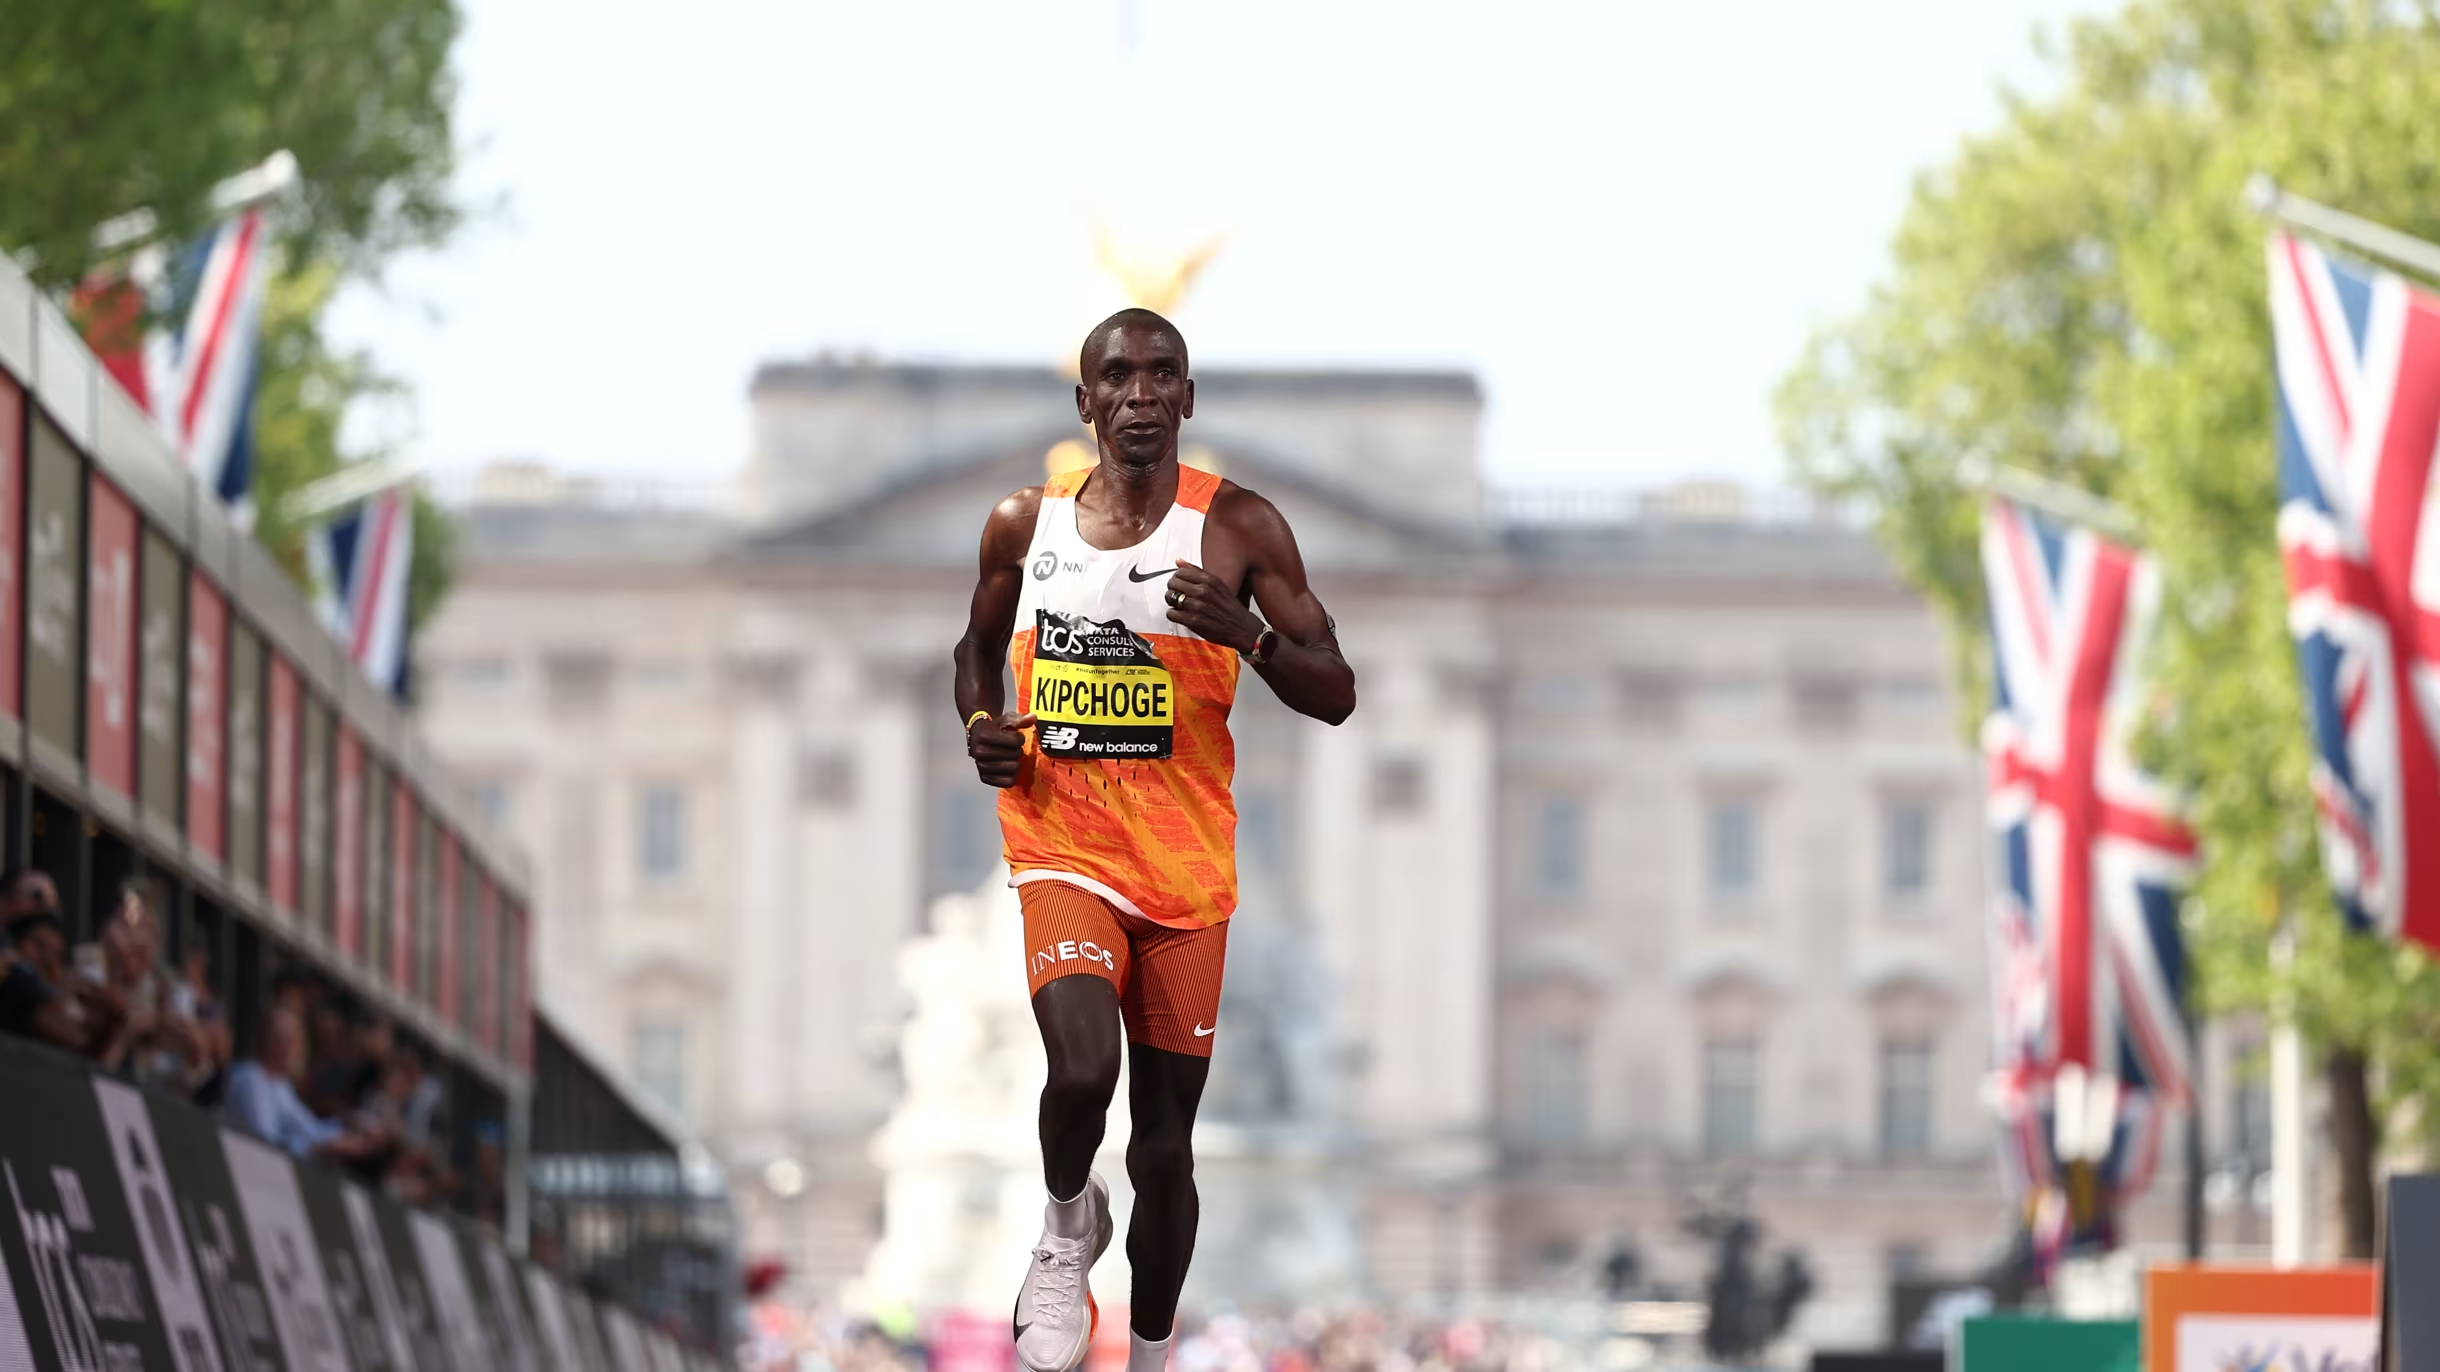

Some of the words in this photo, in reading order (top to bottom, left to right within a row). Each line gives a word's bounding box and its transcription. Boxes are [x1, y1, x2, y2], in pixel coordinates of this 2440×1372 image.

[1042, 618, 1083, 654] tcs
[1088, 647, 1135, 657] SERVICES
[1036, 677, 1167, 718] KIPCHOGE
[1079, 743, 1103, 752] new
[1106, 742, 1158, 752] balance
[1031, 941, 1114, 976] INEOS
